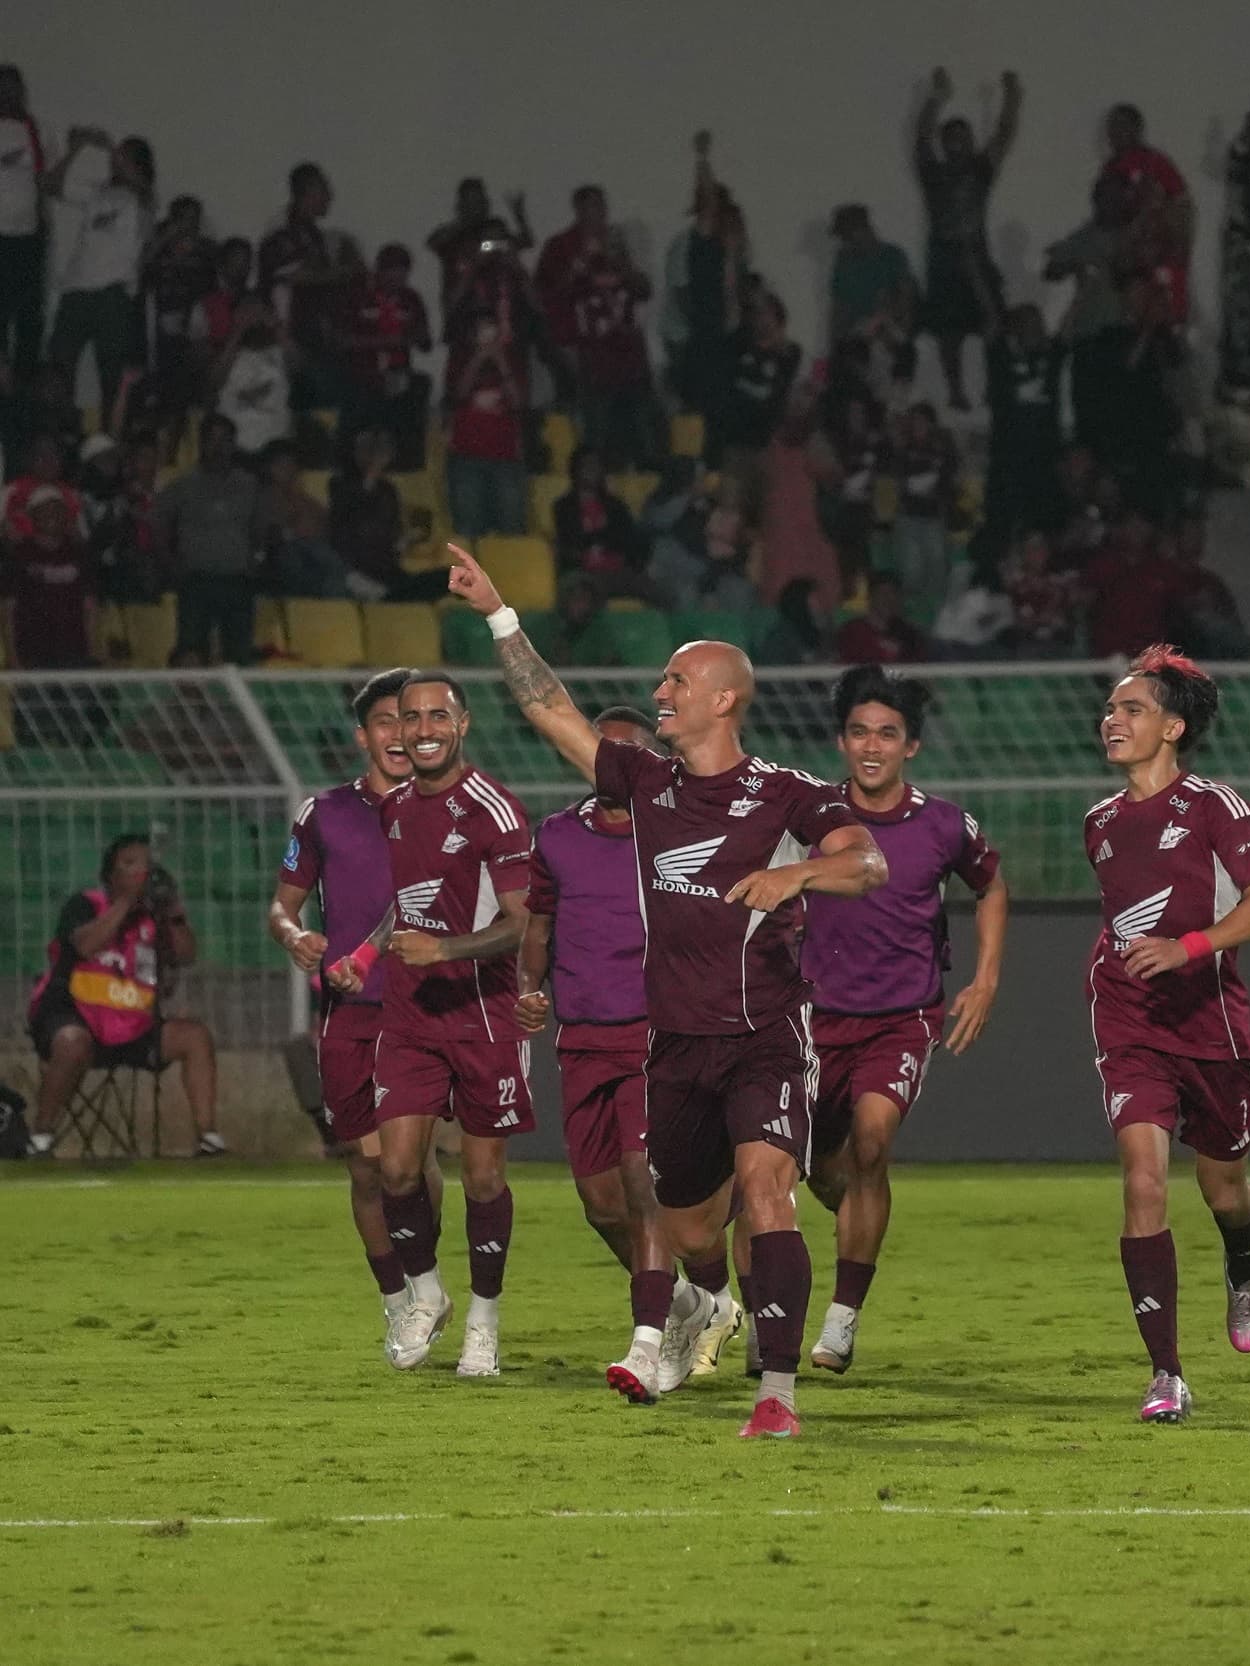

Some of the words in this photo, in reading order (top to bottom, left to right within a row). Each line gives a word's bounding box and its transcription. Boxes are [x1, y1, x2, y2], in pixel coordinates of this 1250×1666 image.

[652, 879, 720, 898] HONDA
[401, 913, 450, 931] ONDA
[899, 1052, 918, 1083] 24
[498, 1076, 516, 1106] 22
[779, 1081, 791, 1110] 8
